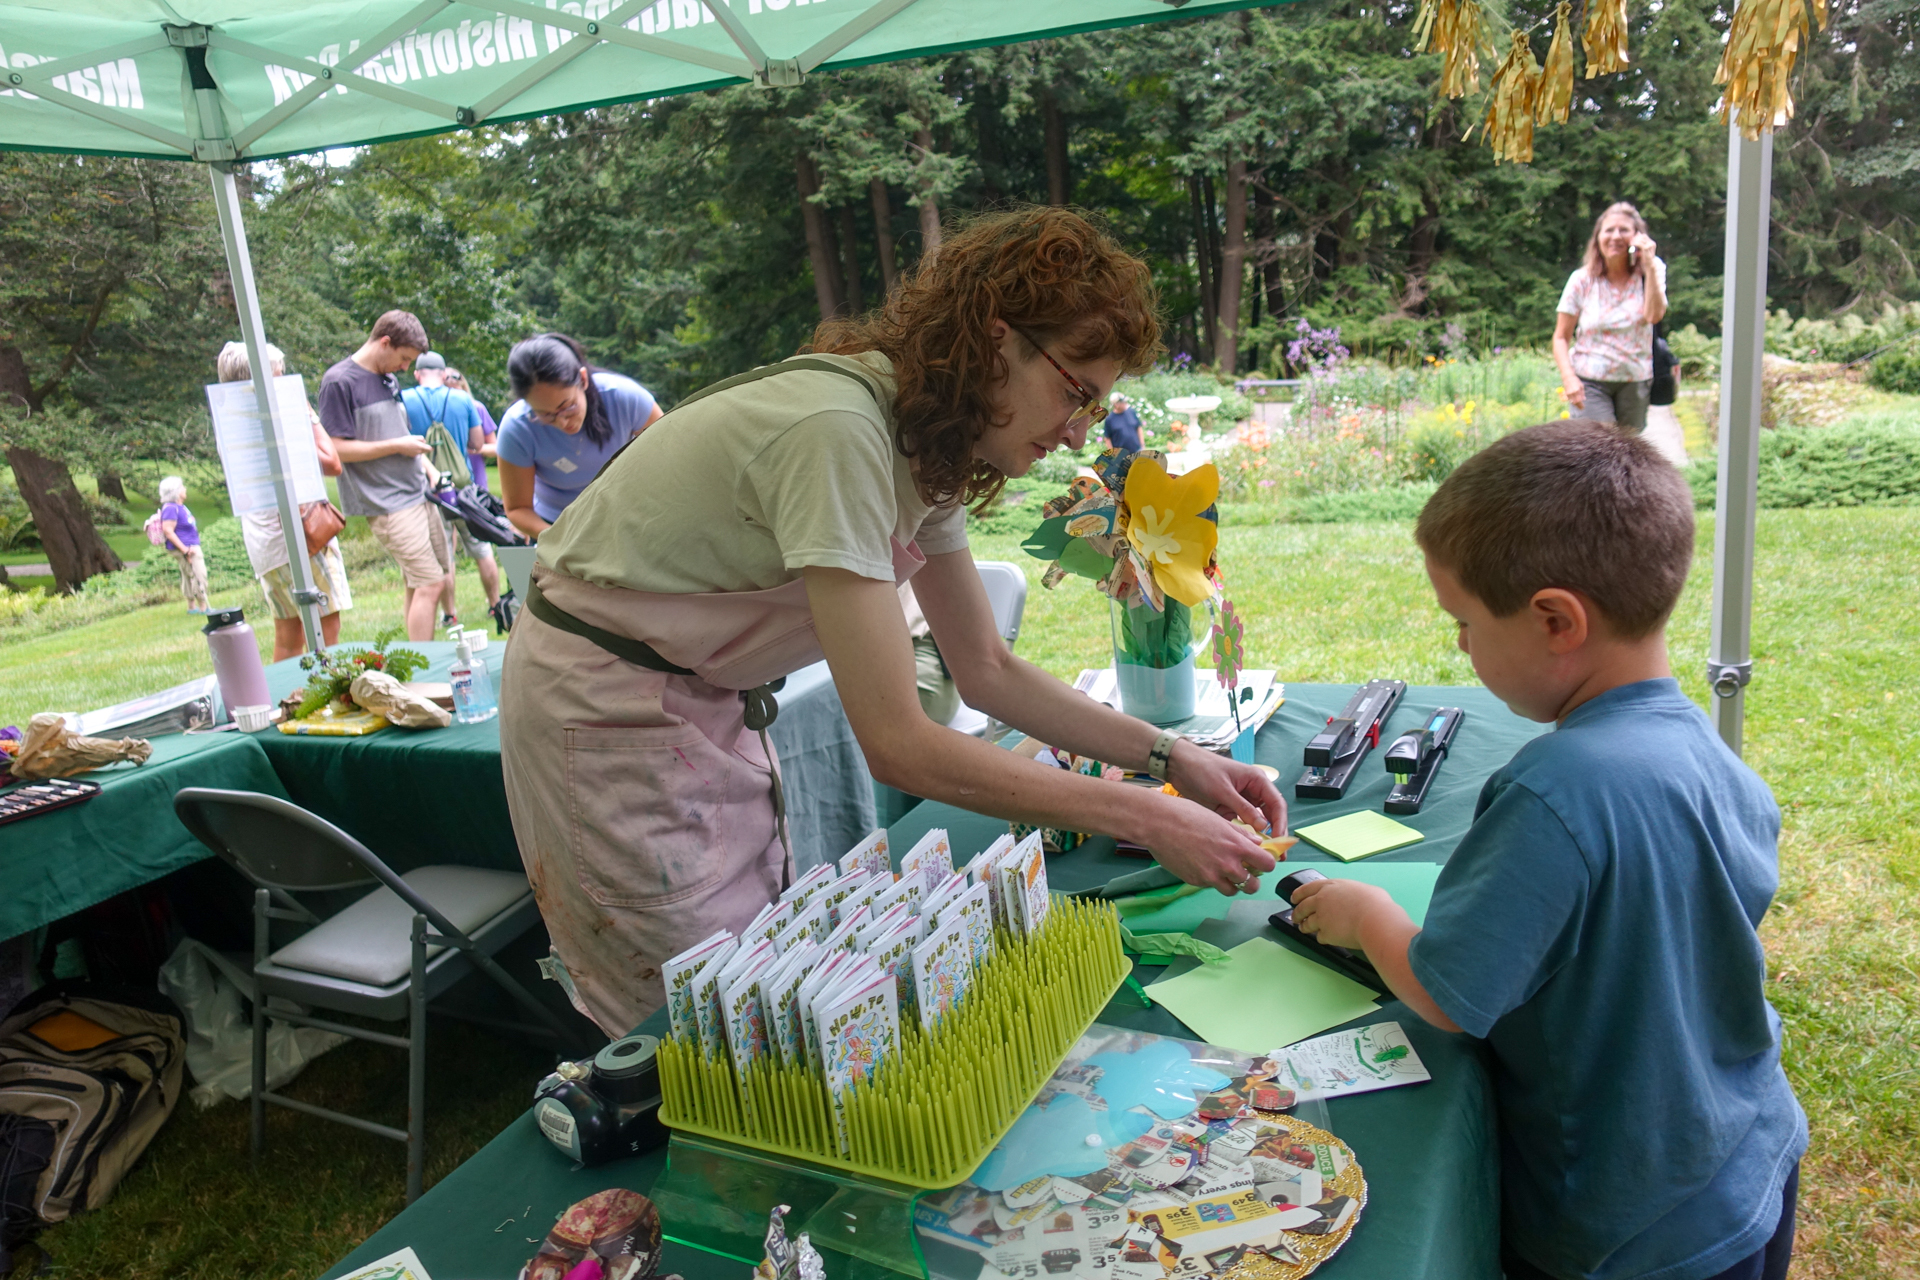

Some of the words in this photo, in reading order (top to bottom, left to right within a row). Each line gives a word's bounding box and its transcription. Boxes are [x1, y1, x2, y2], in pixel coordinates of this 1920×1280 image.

[924, 939, 947, 973] HOW
[948, 932, 960, 947] TO
[829, 1003, 865, 1037] HOW
[868, 994, 884, 1009] TO
[1198, 1184, 1227, 1196] every
[1088, 1214, 1120, 1229] 399
